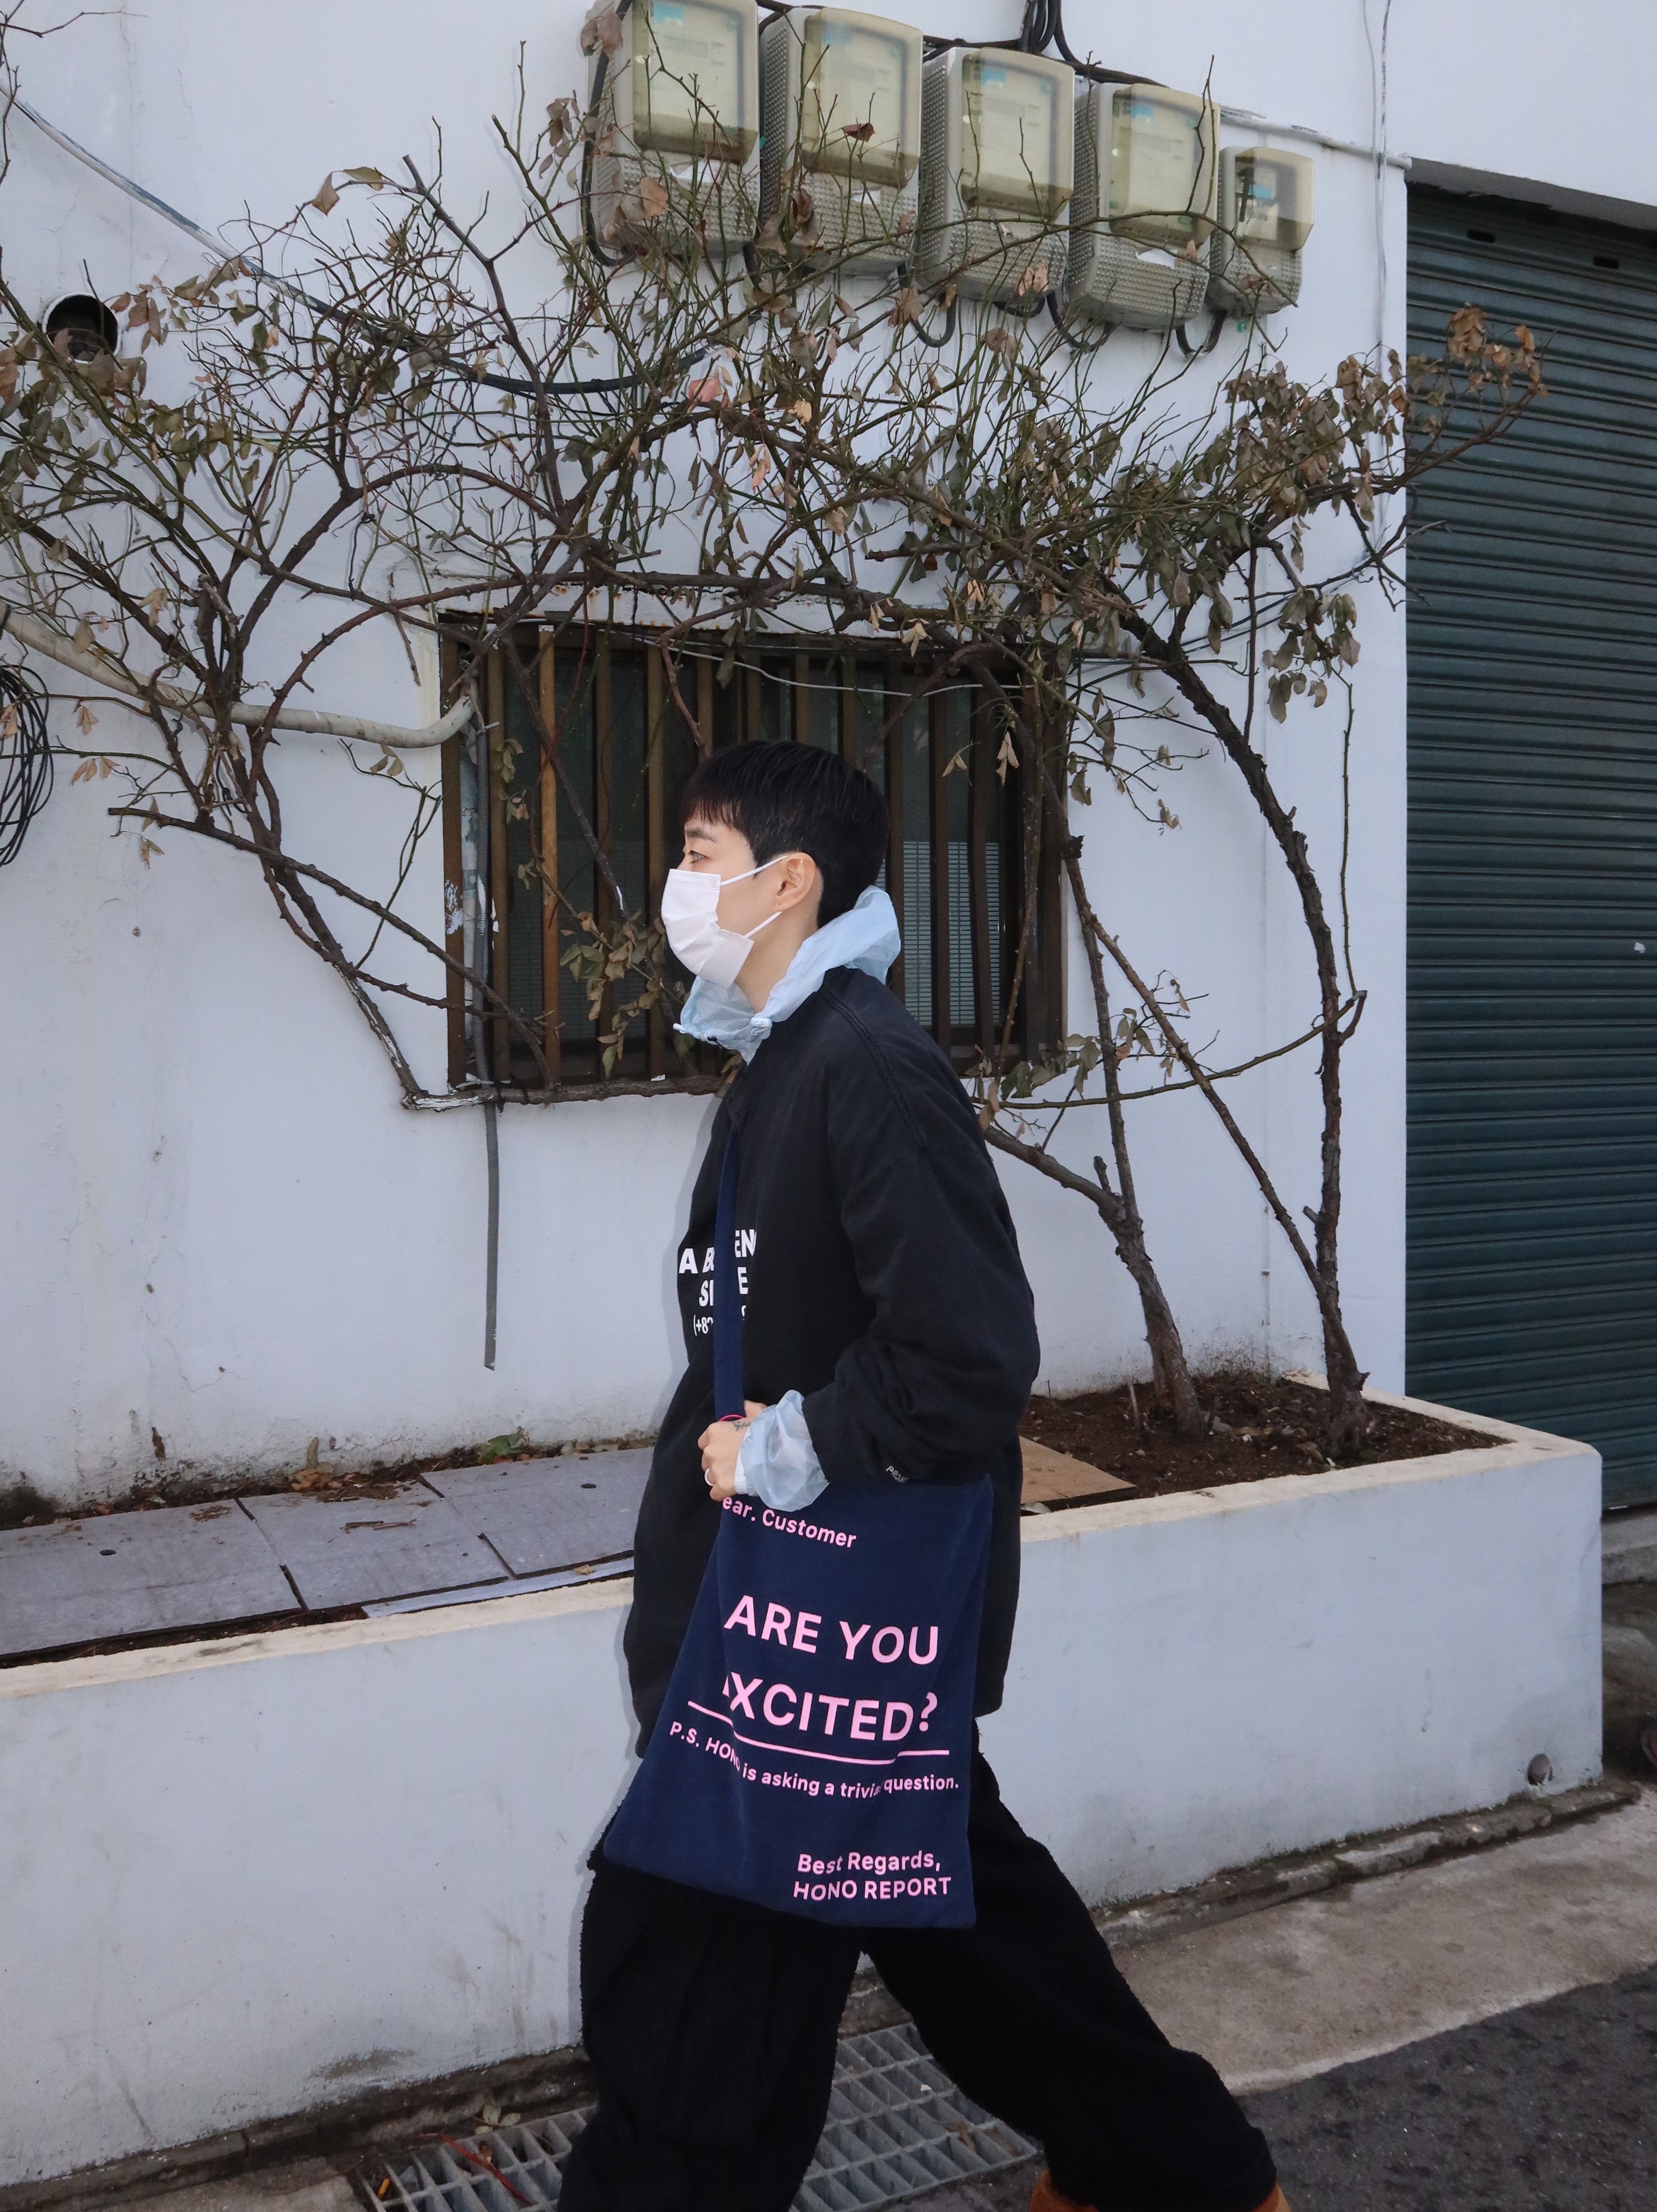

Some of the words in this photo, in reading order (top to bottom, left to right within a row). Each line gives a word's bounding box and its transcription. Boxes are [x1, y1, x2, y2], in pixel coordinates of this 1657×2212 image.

[722, 1496, 756, 1522] ear.
[762, 1509, 857, 1548] Customer
[723, 1595, 822, 1654] ARE
[839, 1620, 939, 1665] YOU
[721, 1671, 938, 1741] XCITED?
[669, 1721, 700, 1748] P.S.
[705, 1736, 741, 1772] HONO
[742, 1762, 757, 1781] is
[761, 1771, 820, 1797] asking
[824, 1783, 835, 1796] a
[883, 1773, 959, 1794] question.
[793, 1880, 857, 1901] HONO
[864, 1876, 951, 1900] REPORT
[797, 1853, 843, 1875] Best
[847, 1850, 941, 1876] Regards,
